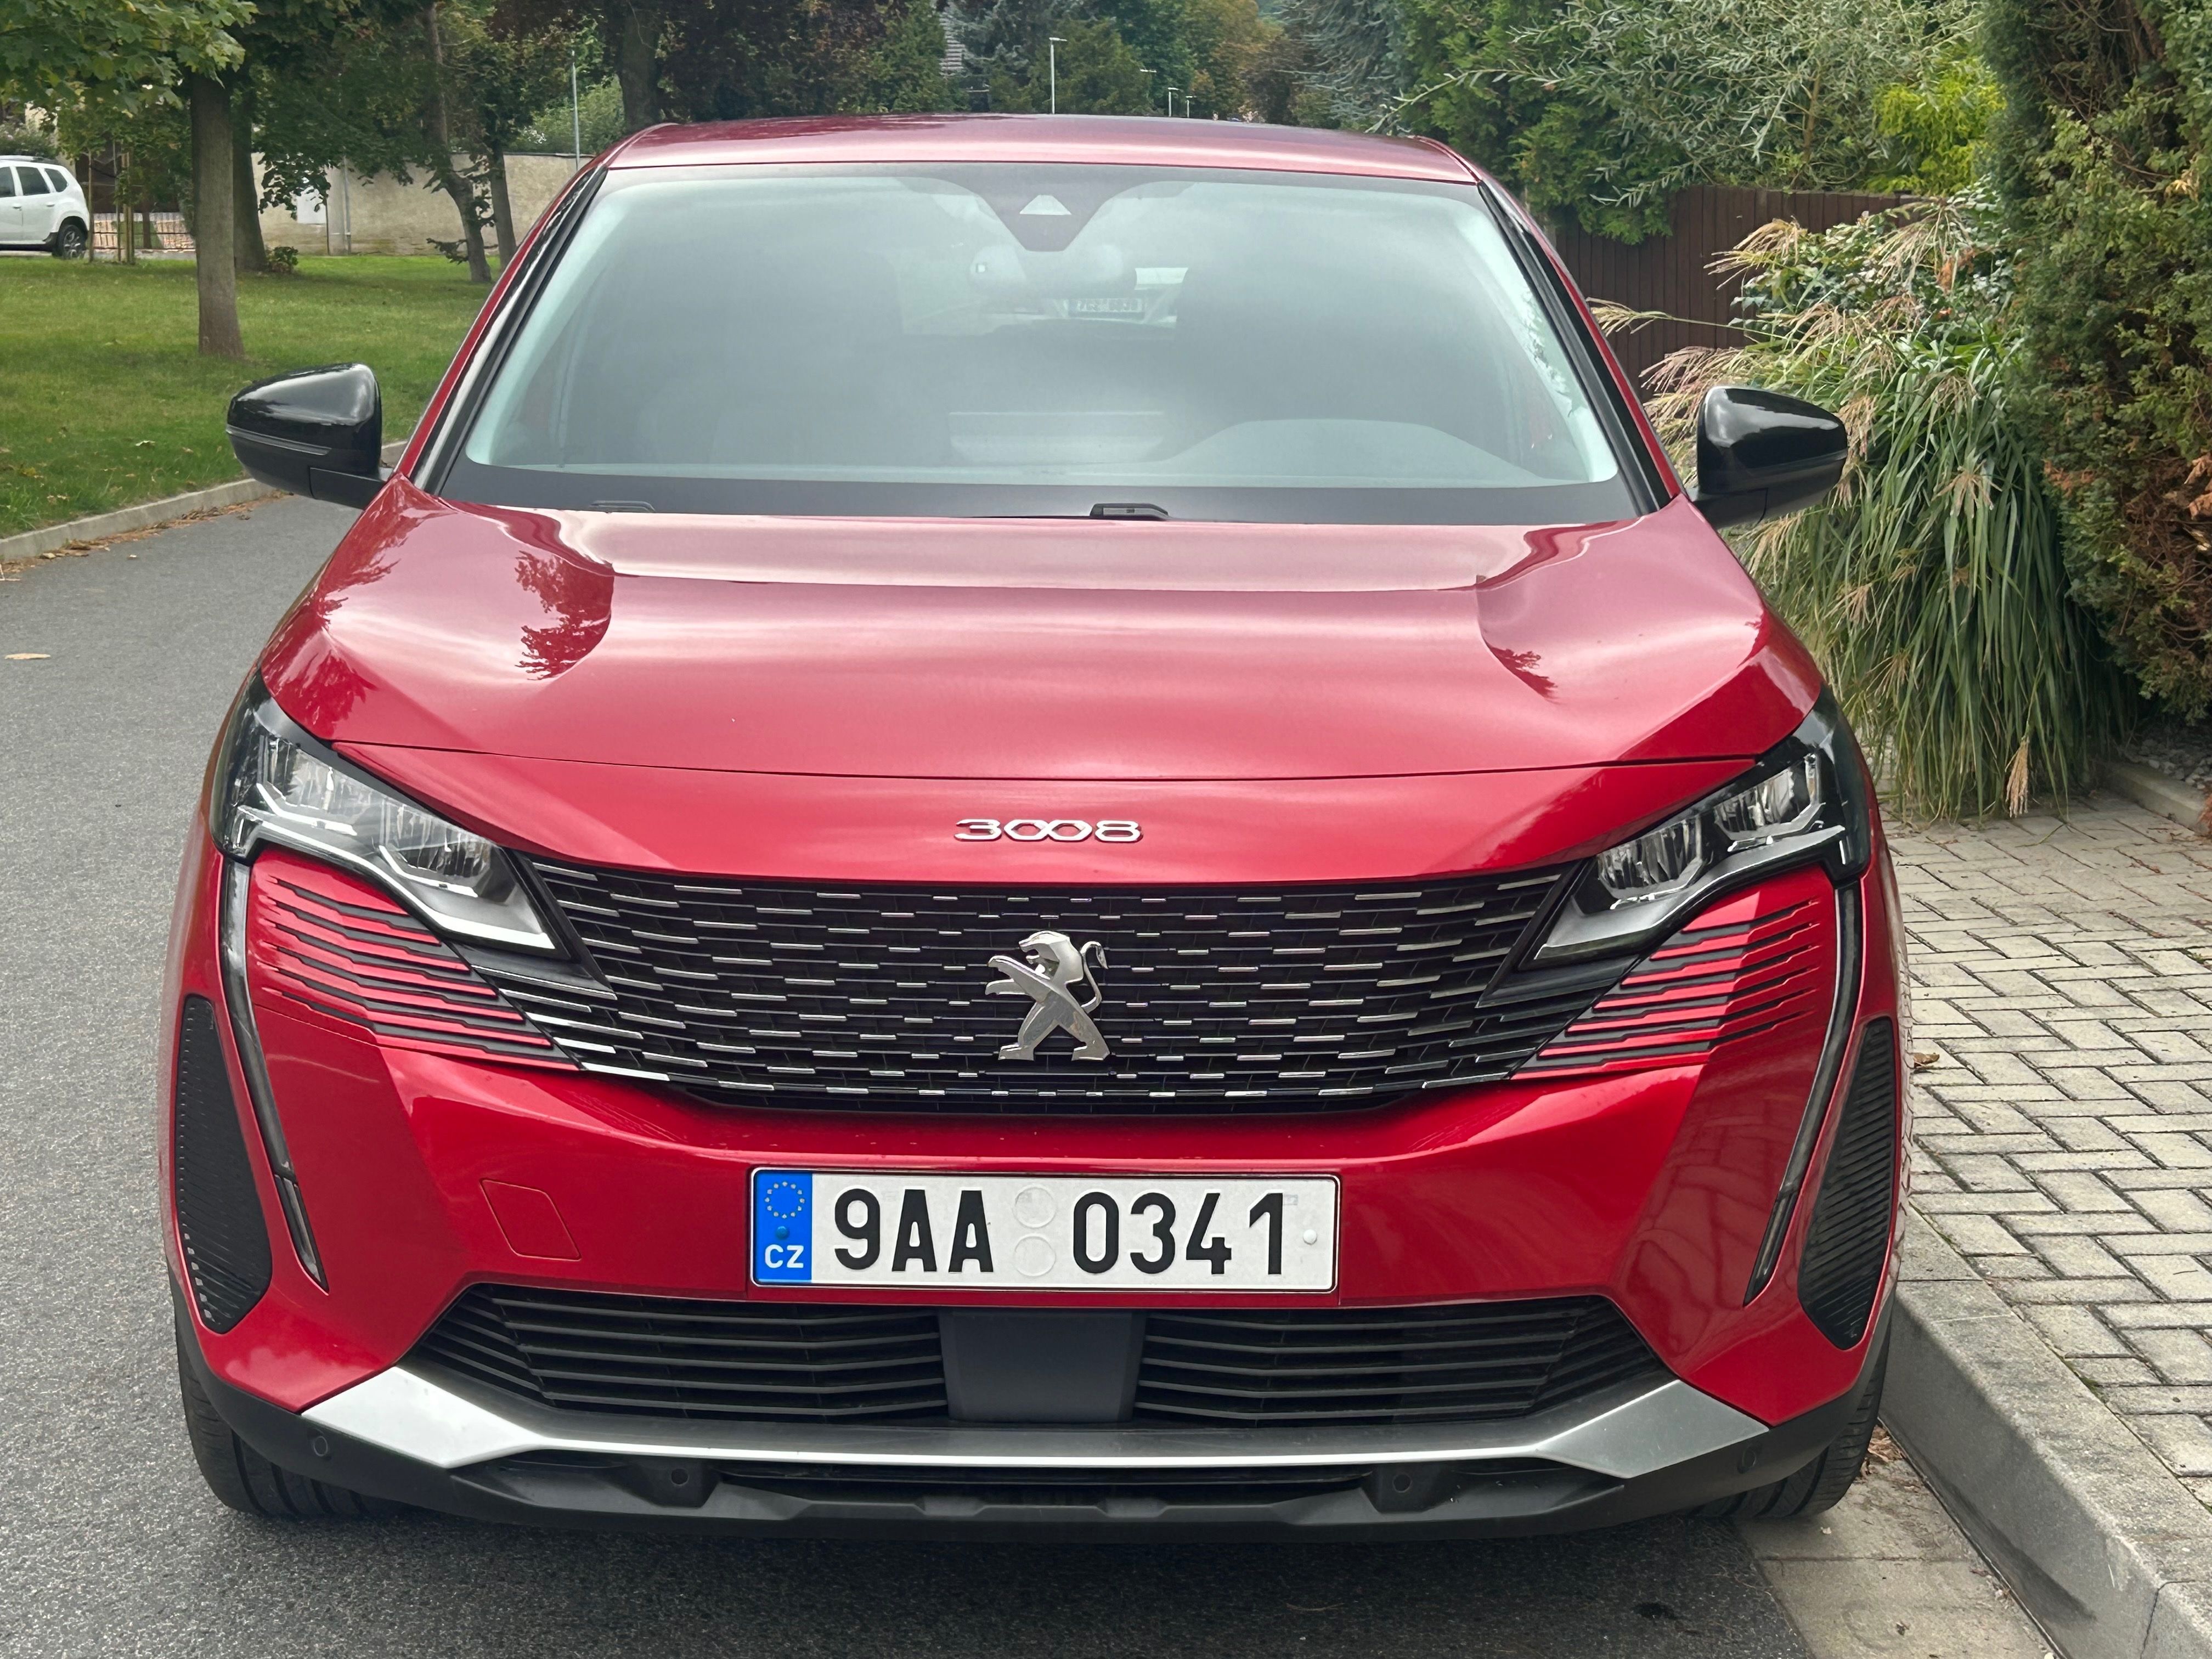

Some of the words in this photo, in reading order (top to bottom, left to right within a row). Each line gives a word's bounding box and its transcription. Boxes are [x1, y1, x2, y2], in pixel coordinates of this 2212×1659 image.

[954, 819, 1142, 842] 3008
[834, 1188, 994, 1273] 9AA
[1073, 1192, 1283, 1275] 0341
[765, 1244, 804, 1268] CZ
